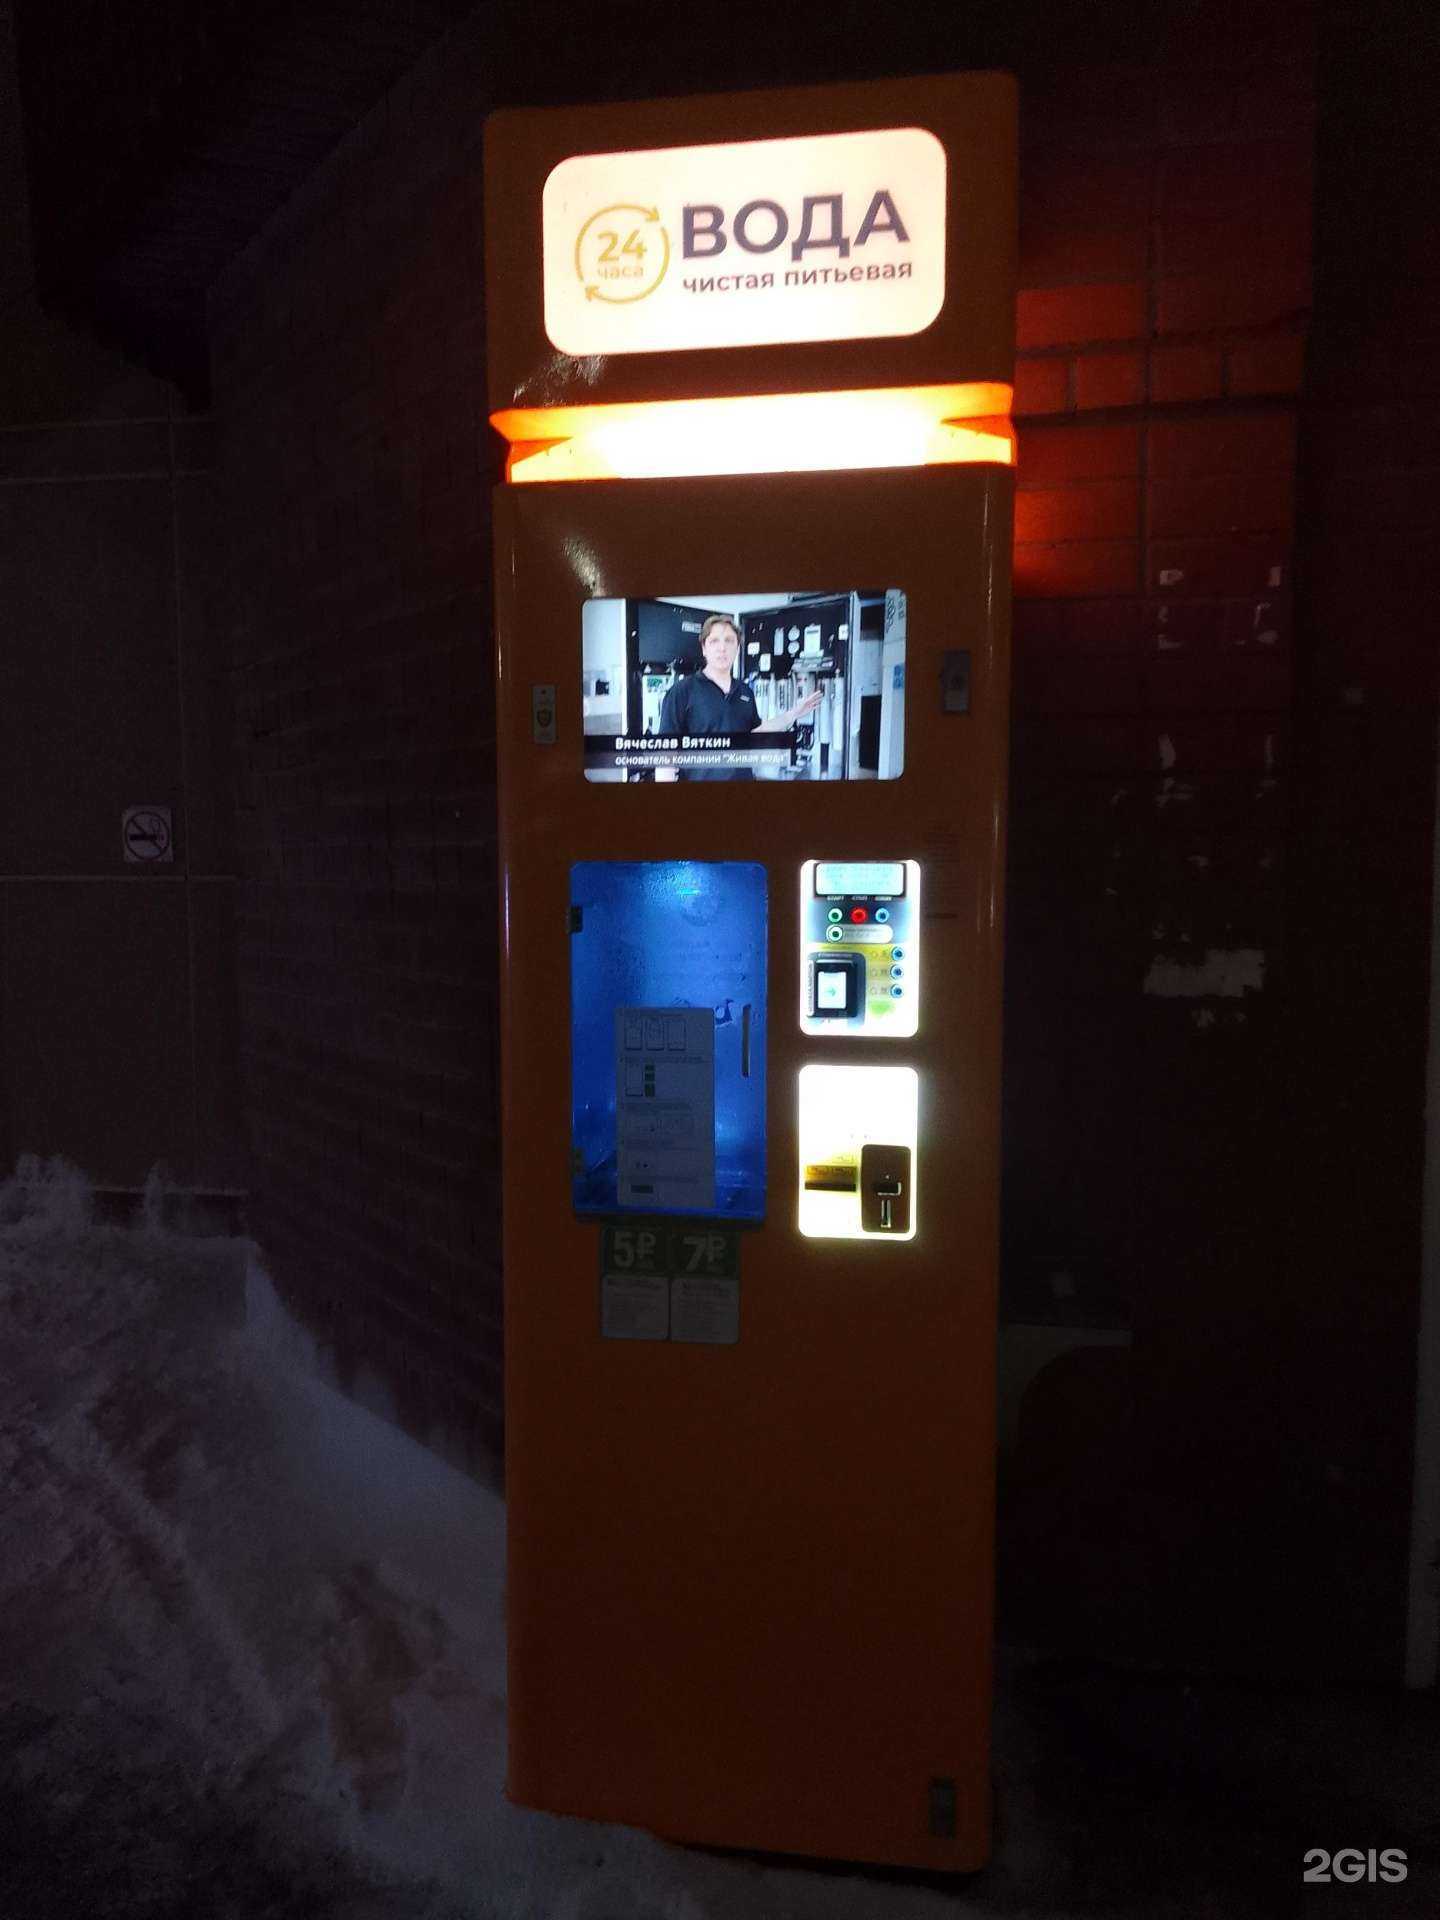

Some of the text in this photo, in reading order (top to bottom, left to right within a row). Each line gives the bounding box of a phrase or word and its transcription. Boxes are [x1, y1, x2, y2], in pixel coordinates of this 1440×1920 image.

[682, 189, 911, 262] ВОДА
[597, 229, 647, 262] 24
[597, 266, 644, 280] часа
[683, 262, 913, 293] чистая питьевая
[615, 736, 731, 750] Вячеслав Вяткин
[615, 755, 670, 766] основатель
[672, 754, 721, 764] компании
